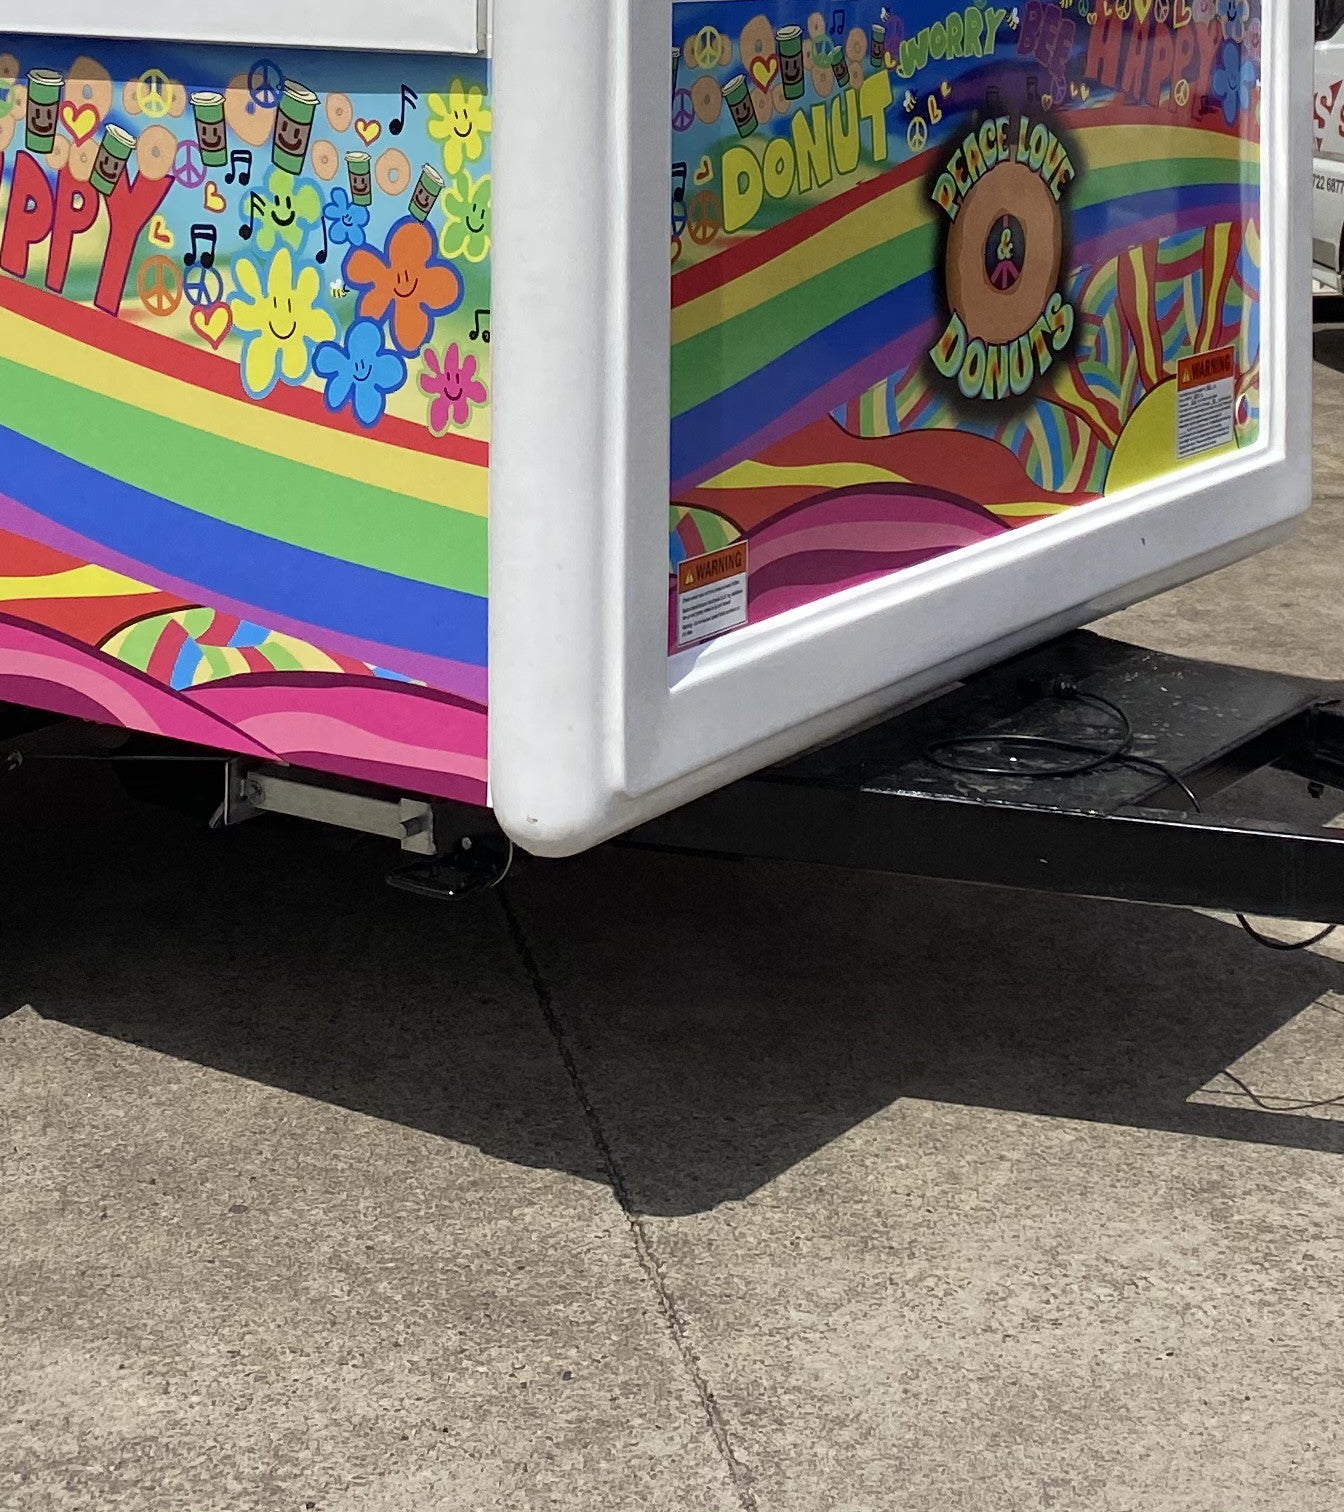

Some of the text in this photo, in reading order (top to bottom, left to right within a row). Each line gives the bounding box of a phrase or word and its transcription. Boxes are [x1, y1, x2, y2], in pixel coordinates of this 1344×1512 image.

[721, 69, 894, 234] DONUT
[898, 7, 1007, 79] WORRY
[1017, 0, 1076, 77] BEE
[931, 115, 1076, 221] PEACE LOVE
[997, 227, 1014, 261] &
[929, 292, 1075, 401] DONUTS
[696, 551, 742, 581] WARNING
